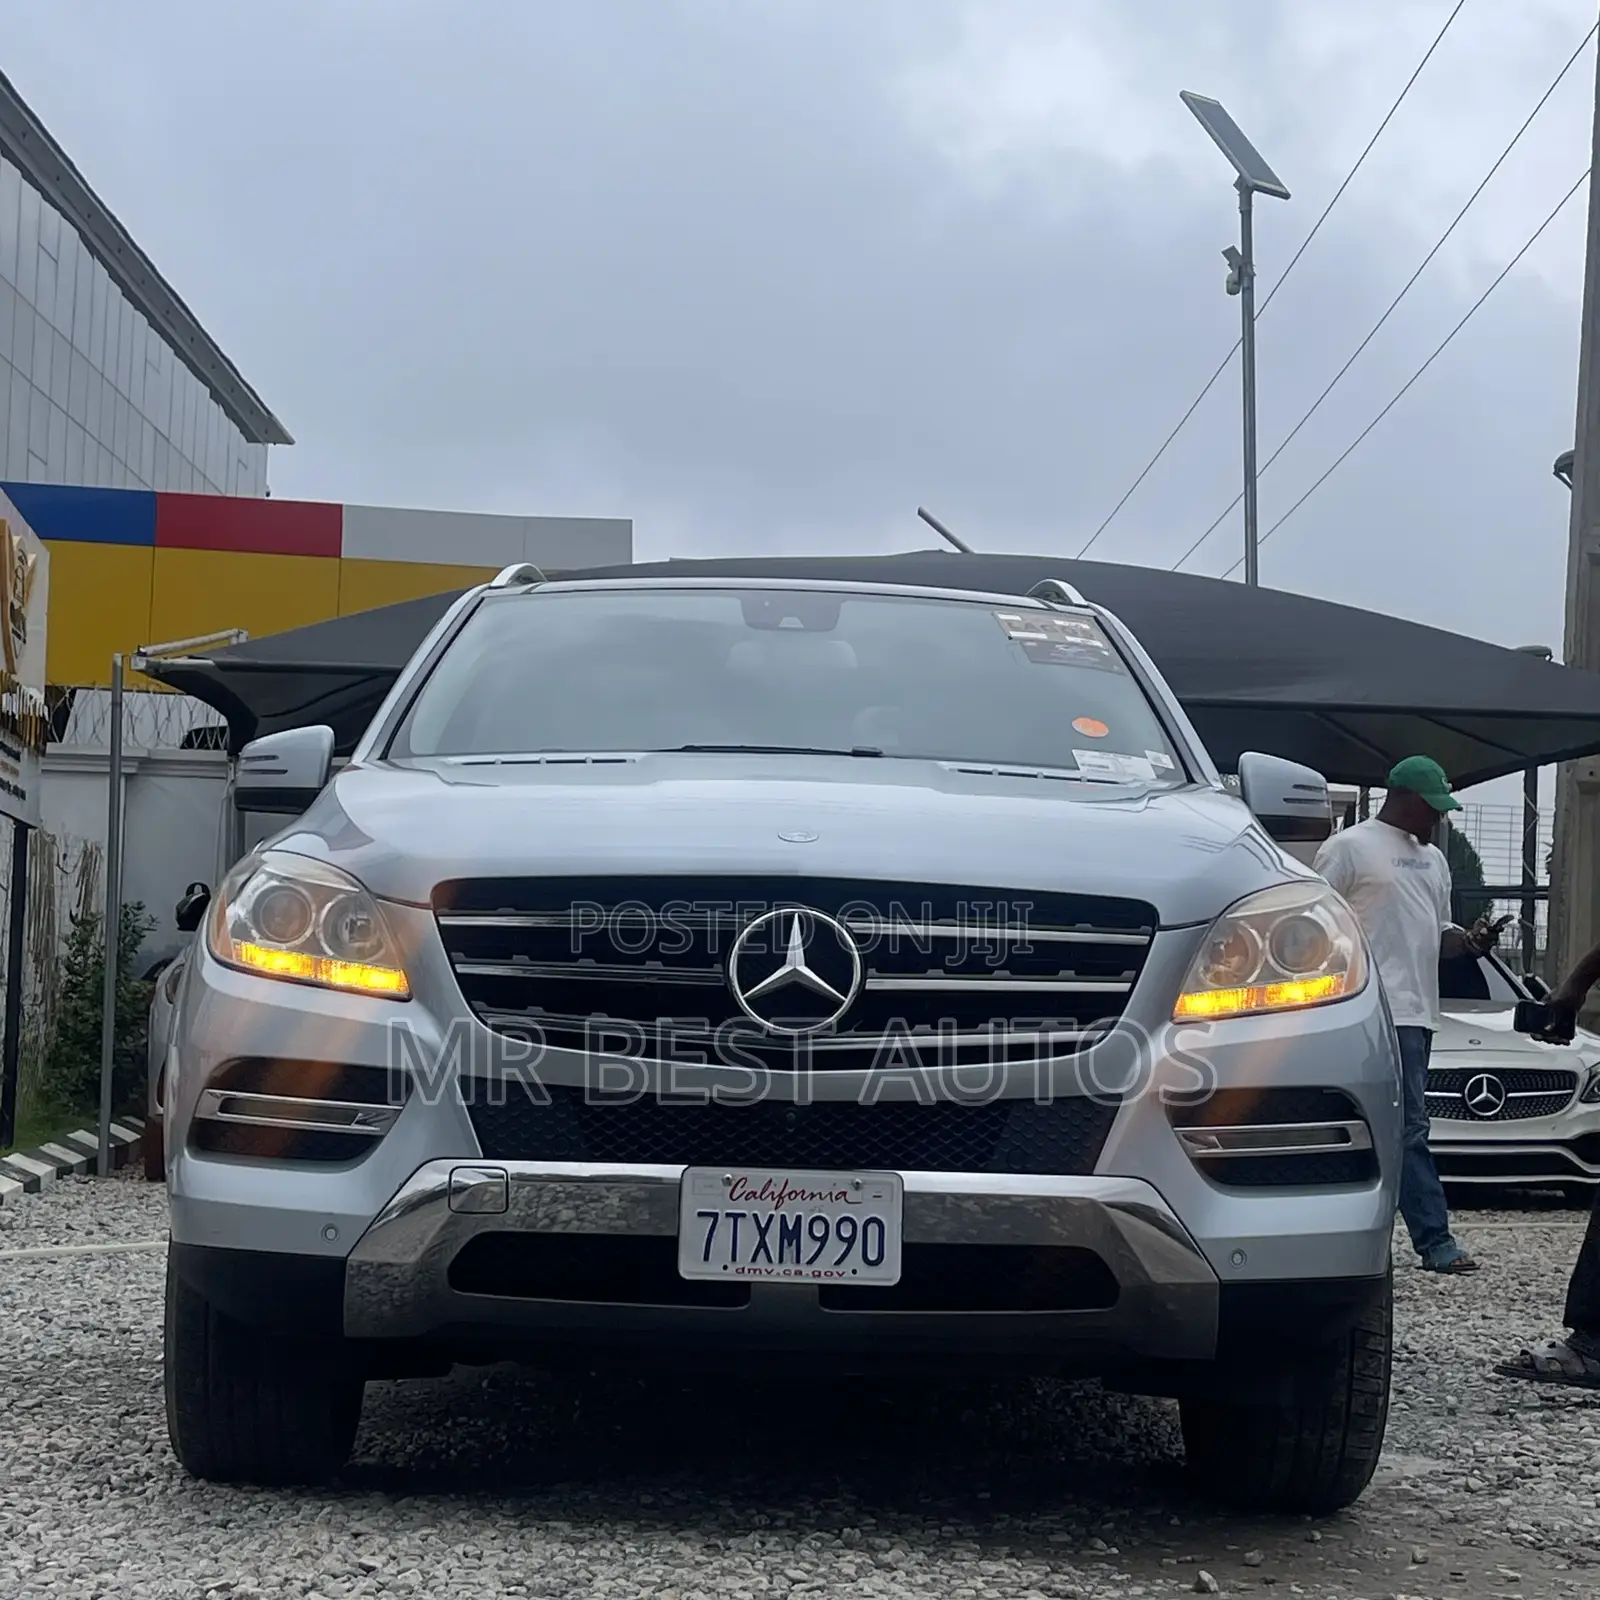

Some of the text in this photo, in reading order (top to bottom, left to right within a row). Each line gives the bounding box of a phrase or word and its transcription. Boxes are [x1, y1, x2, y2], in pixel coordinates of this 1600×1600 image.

[729, 1177, 862, 1210] California
[697, 1211, 885, 1267] 7TXM990
[735, 1265, 847, 1279] dmv.ca.gov
